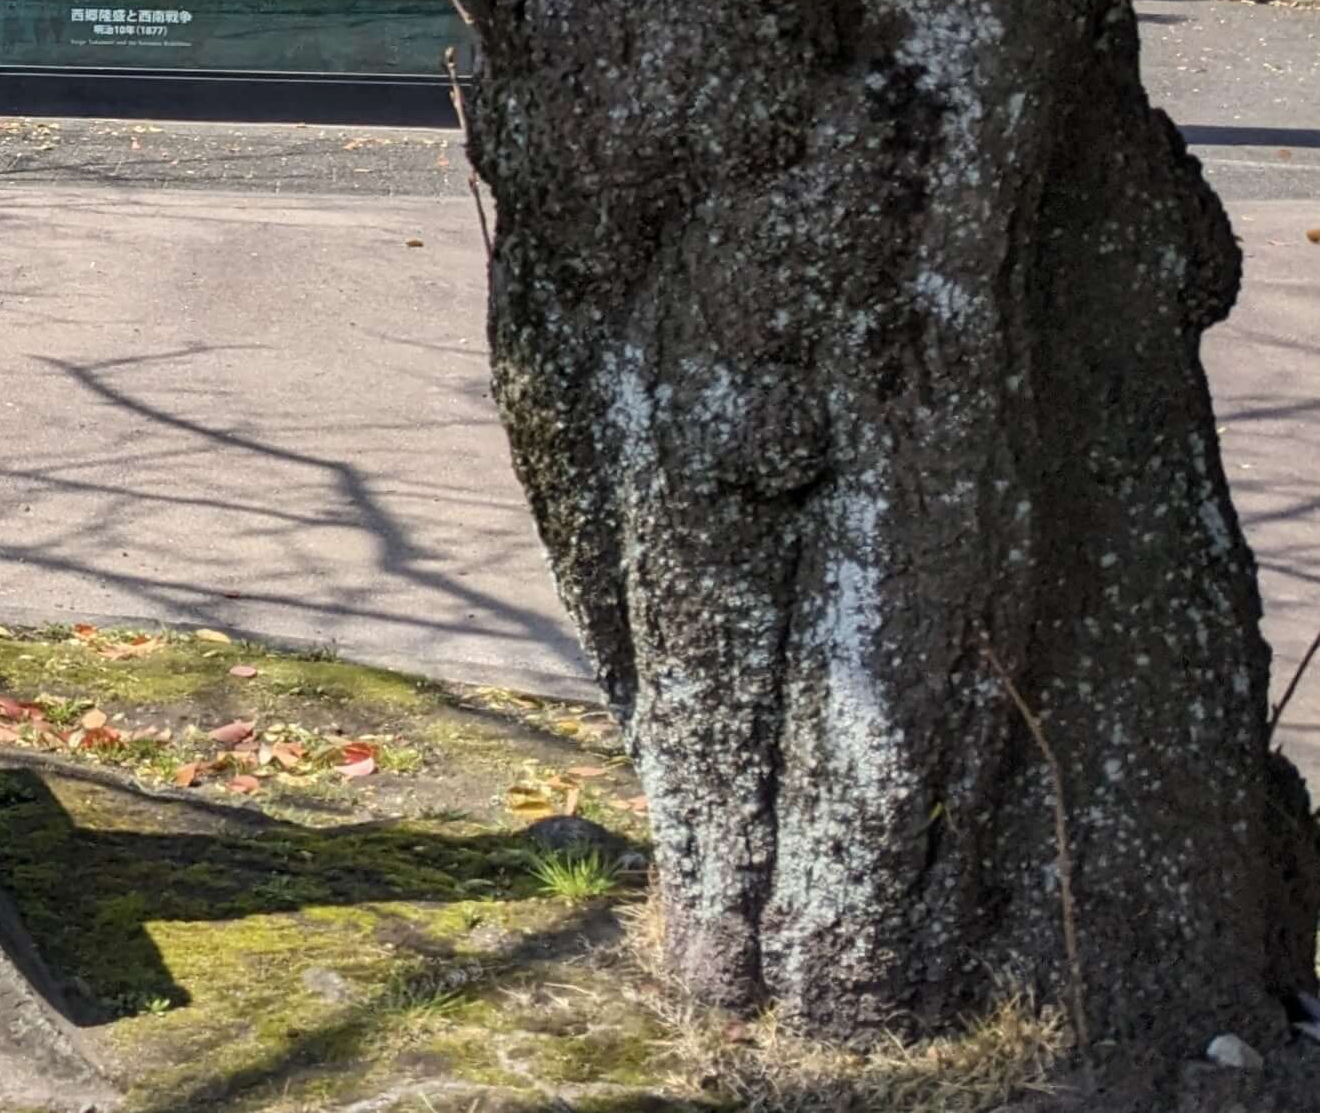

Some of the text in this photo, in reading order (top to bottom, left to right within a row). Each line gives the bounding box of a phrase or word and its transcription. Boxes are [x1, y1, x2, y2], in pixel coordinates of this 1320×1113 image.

[70, 8, 193, 24] 西郷隆盛と西南戦争
[93, 25, 168, 37] 明治10年(1877)
